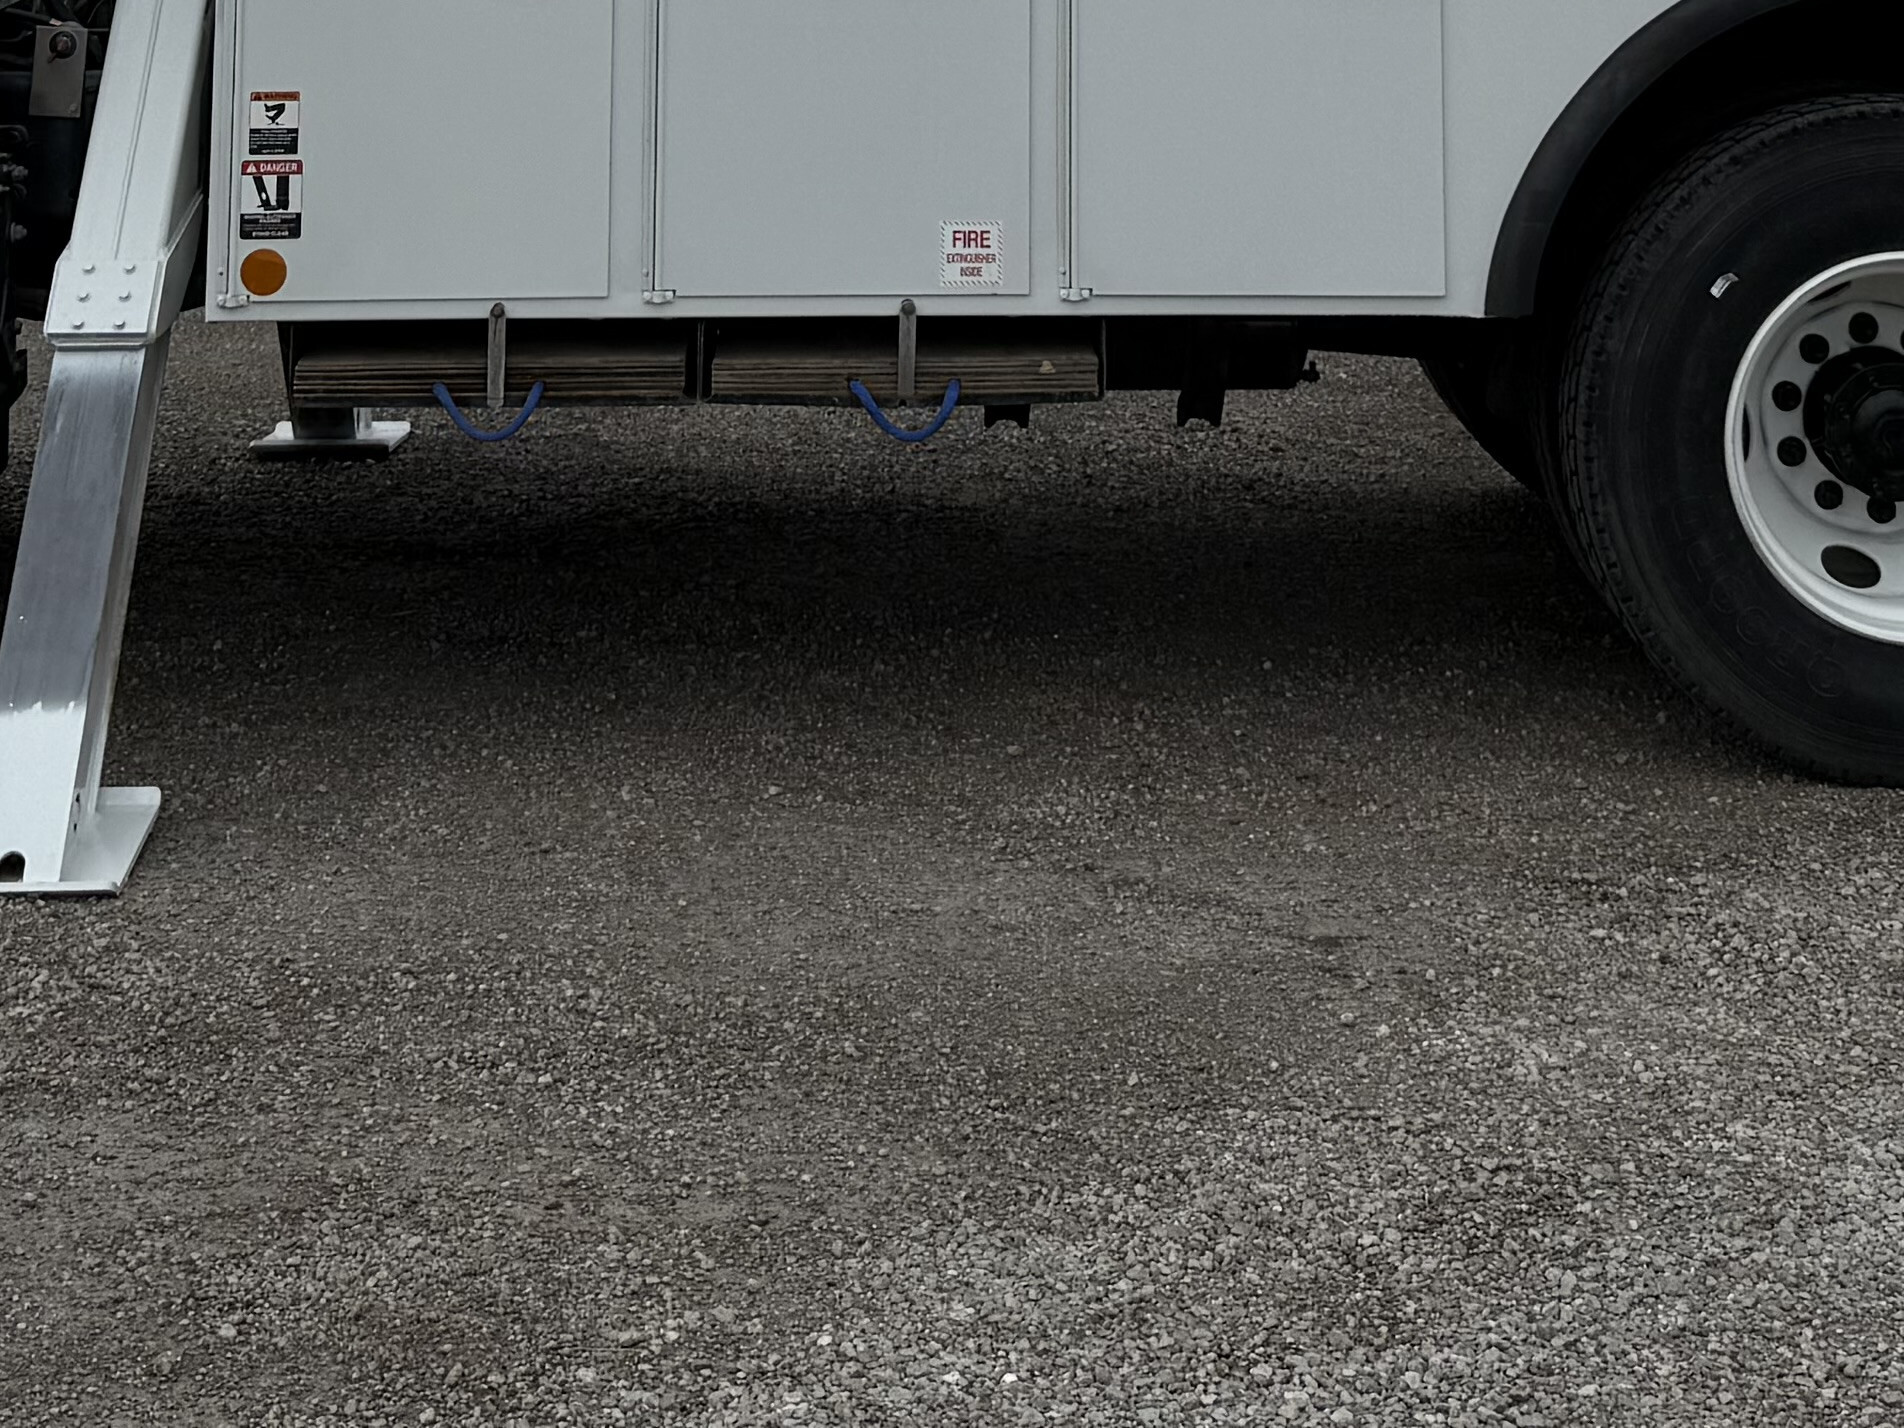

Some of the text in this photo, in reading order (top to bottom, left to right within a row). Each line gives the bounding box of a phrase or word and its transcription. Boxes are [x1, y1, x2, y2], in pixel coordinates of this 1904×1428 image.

[259, 163, 297, 172] DANGER
[952, 230, 991, 249] FIRE
[946, 253, 996, 264] EXTINGUISHER
[959, 266, 983, 277] INSIDE
